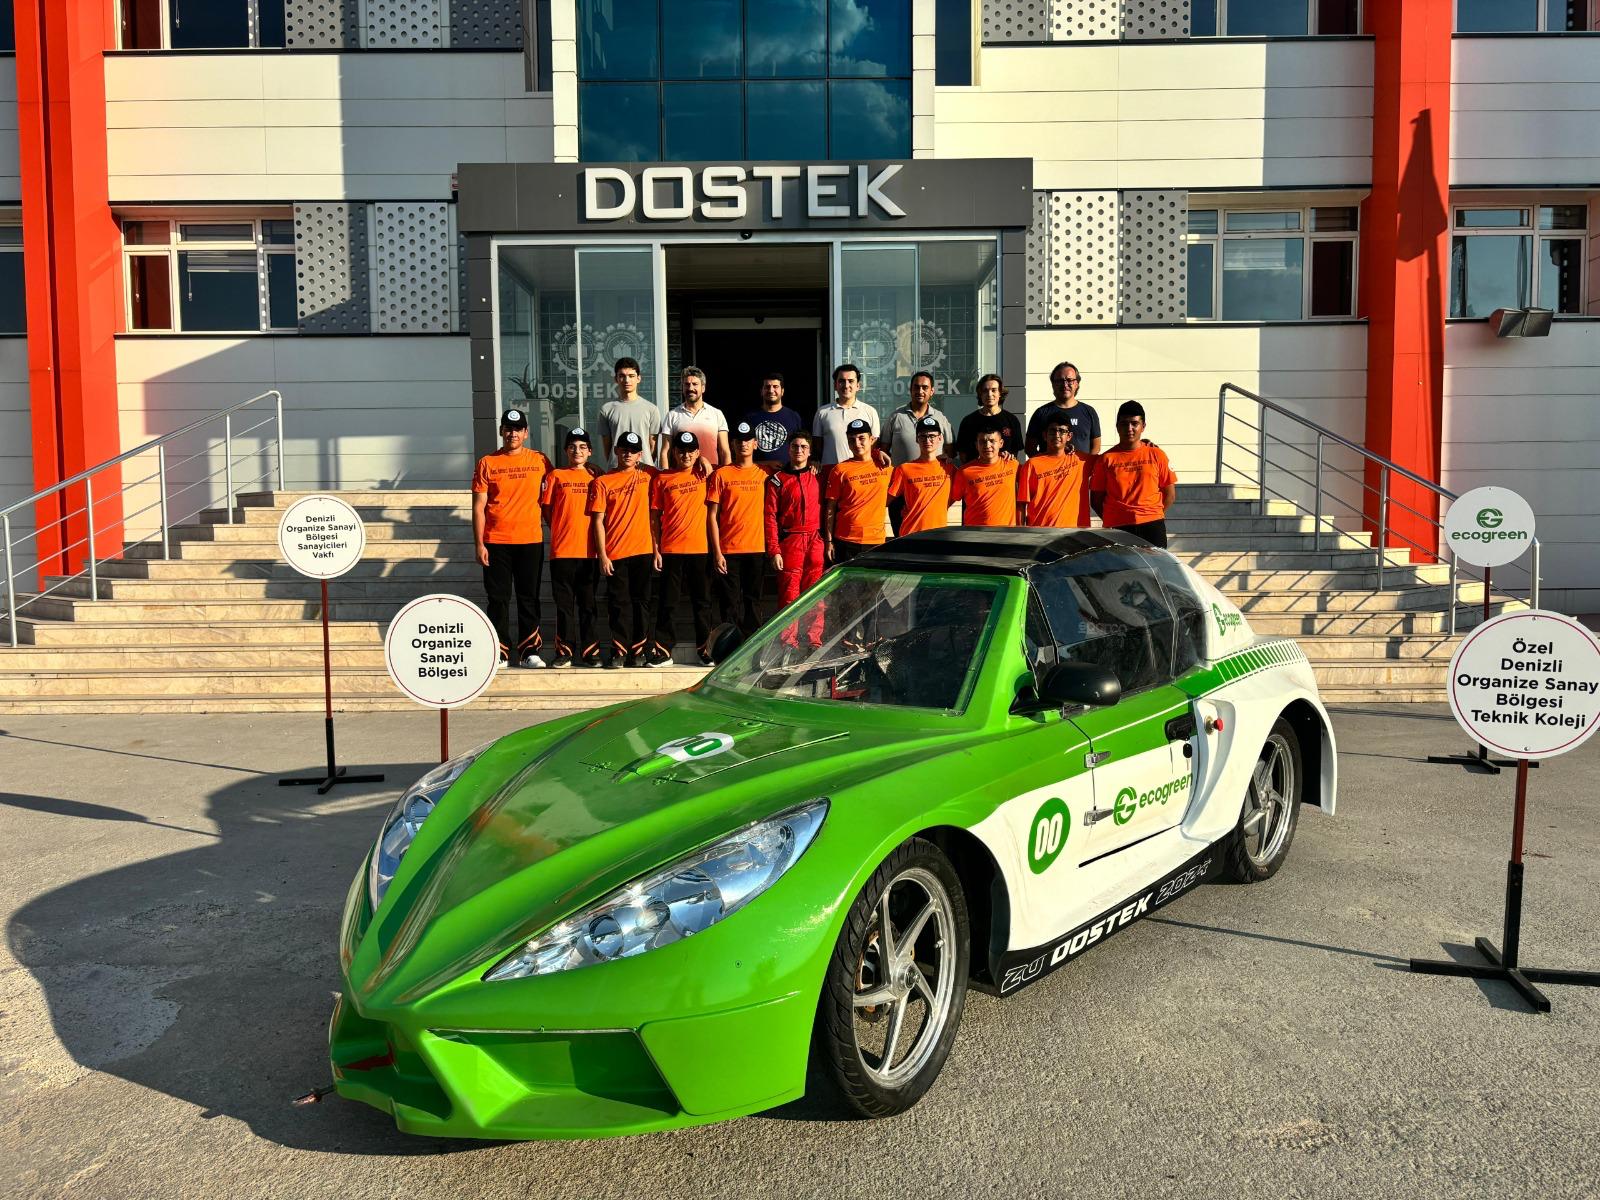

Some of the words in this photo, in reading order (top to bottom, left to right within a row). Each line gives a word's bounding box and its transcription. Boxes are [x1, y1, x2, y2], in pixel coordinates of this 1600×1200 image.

[585, 164, 906, 220] DOSTEK
[305, 515, 336, 523] Denizli
[286, 524, 326, 533] Organize
[327, 523, 356, 532] Sanayi
[305, 533, 338, 542] Bölgesi
[1451, 530, 1528, 544] ecogreen
[297, 542, 347, 551] Sanayicileri
[312, 551, 334, 559] Vakfı
[418, 623, 464, 635] Denizli
[411, 638, 472, 651] Organize
[1512, 637, 1553, 655] Özel
[420, 652, 464, 665] Sanayi
[1501, 657, 1563, 673] Denizli
[418, 666, 468, 680] Bölgesi
[1457, 673, 1539, 690] Organize
[1496, 693, 1563, 710] Bölgesi
[1471, 709, 1529, 725] Teknik
[1535, 712, 1586, 730] Koleji
[1139, 772, 1193, 808] ecogreen
[1034, 812, 1064, 861] 00
[1049, 892, 1154, 967] DOSTEK
[1155, 858, 1212, 906] 2024
